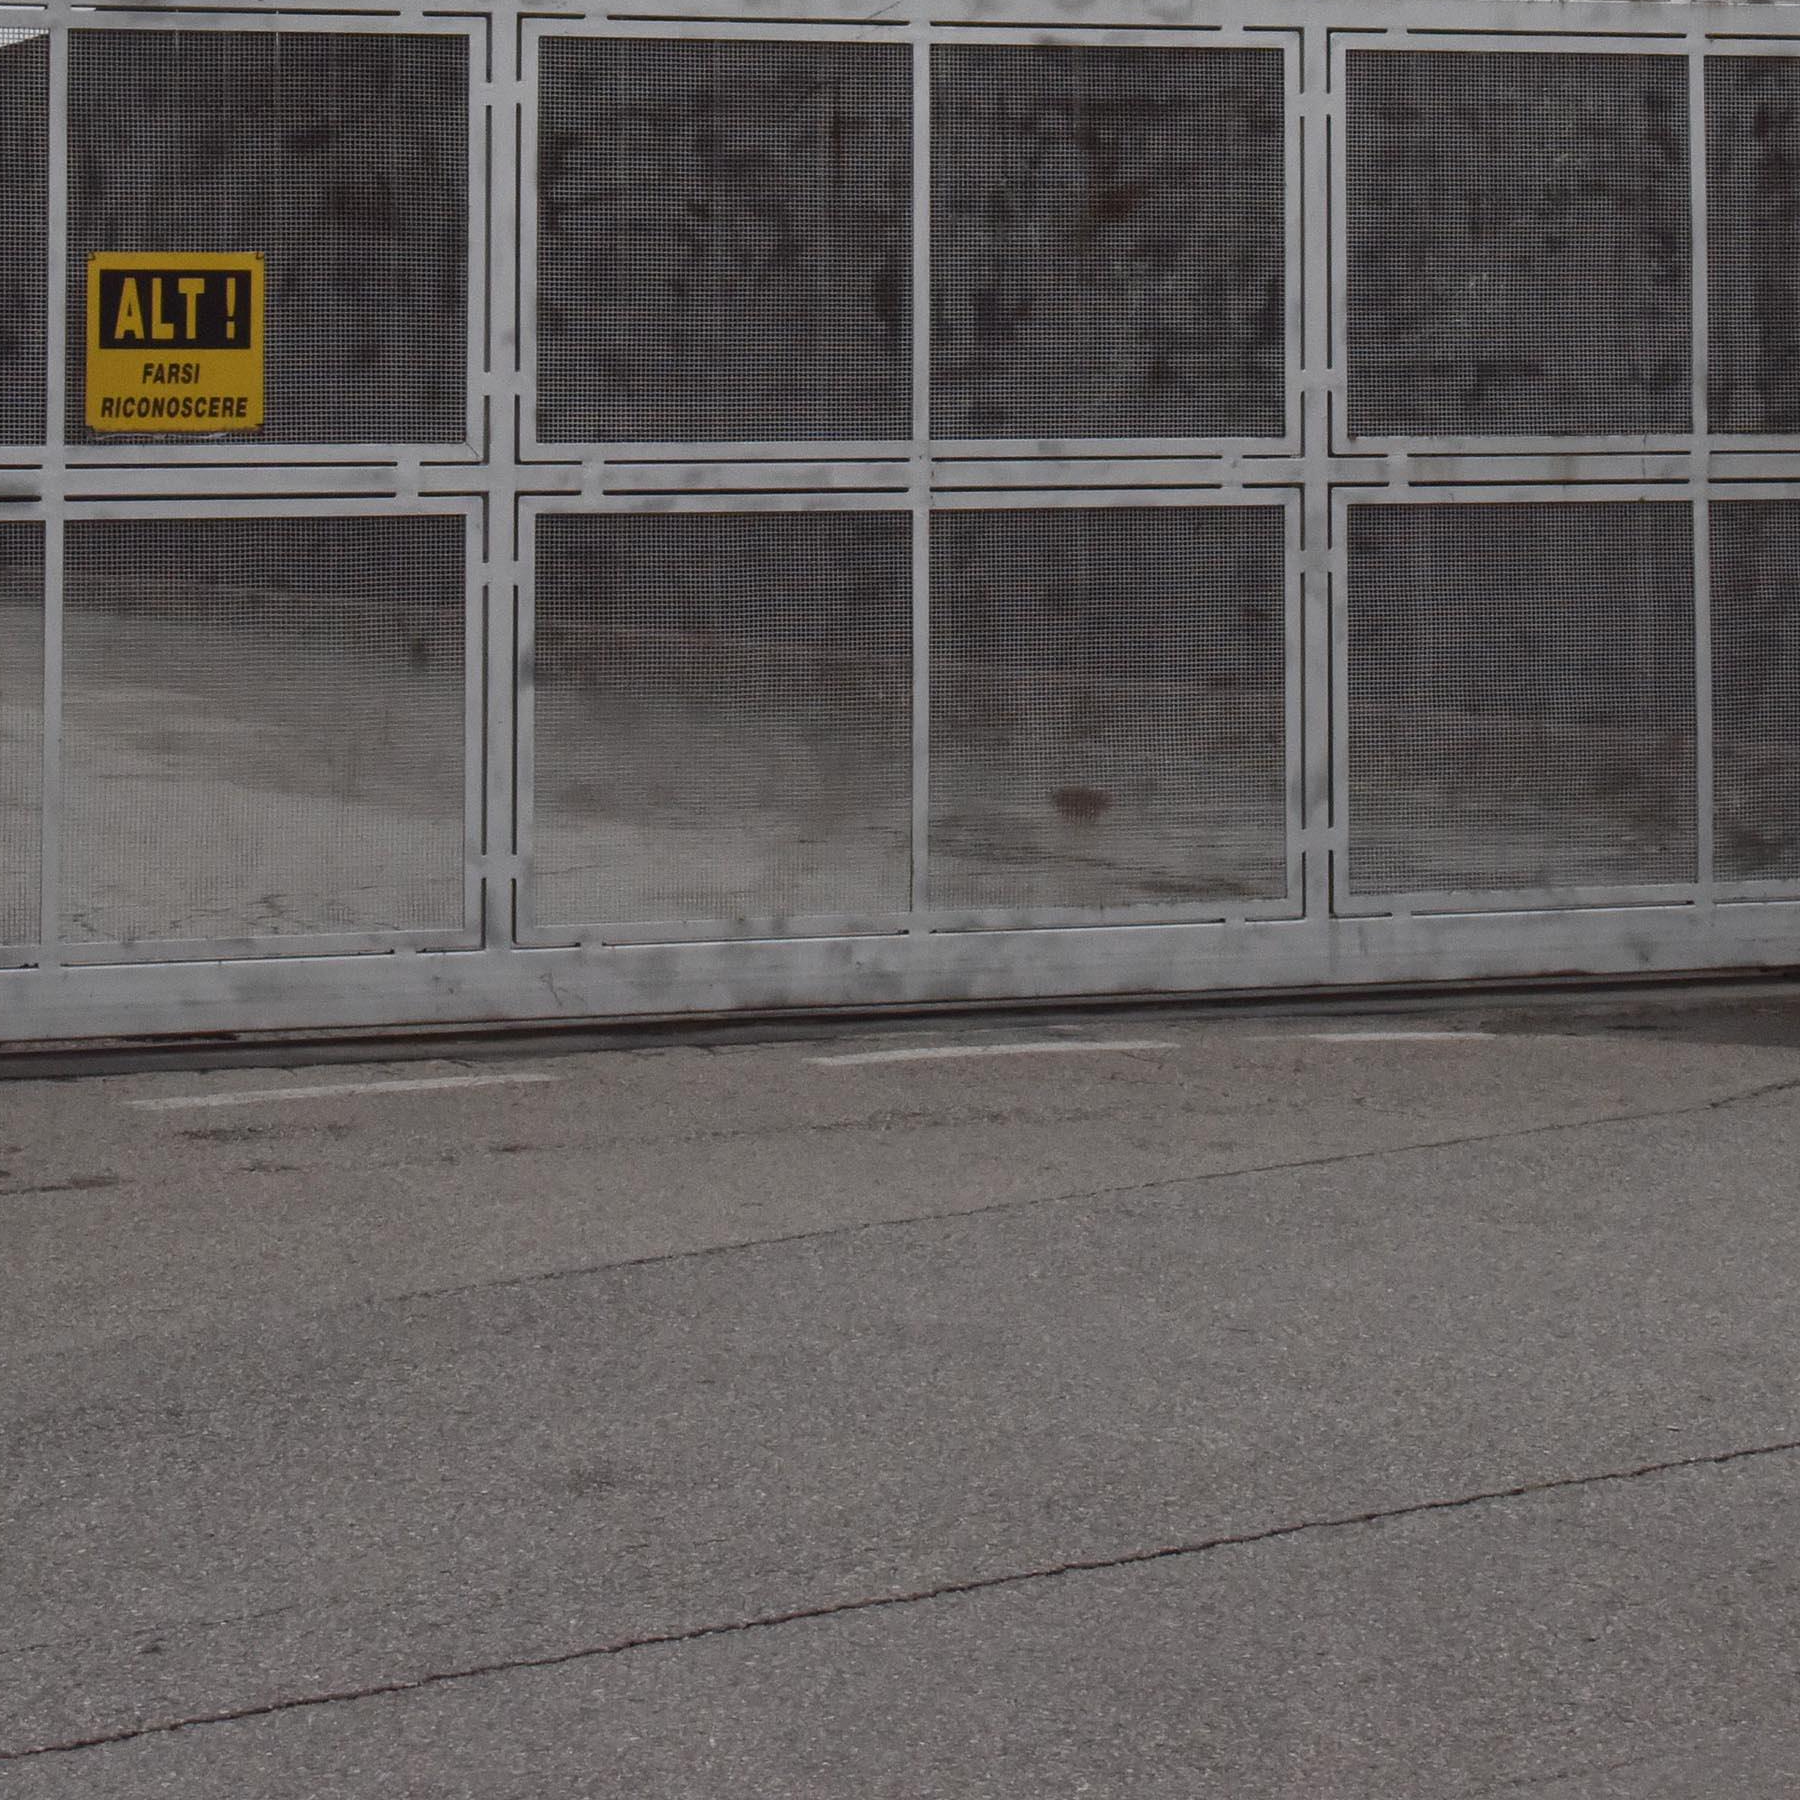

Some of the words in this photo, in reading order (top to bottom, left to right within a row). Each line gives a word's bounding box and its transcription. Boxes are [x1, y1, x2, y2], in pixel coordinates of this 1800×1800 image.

[114, 277, 205, 340] ALT
[142, 363, 200, 384] FARSI
[101, 397, 248, 418] RICONOSCERE
